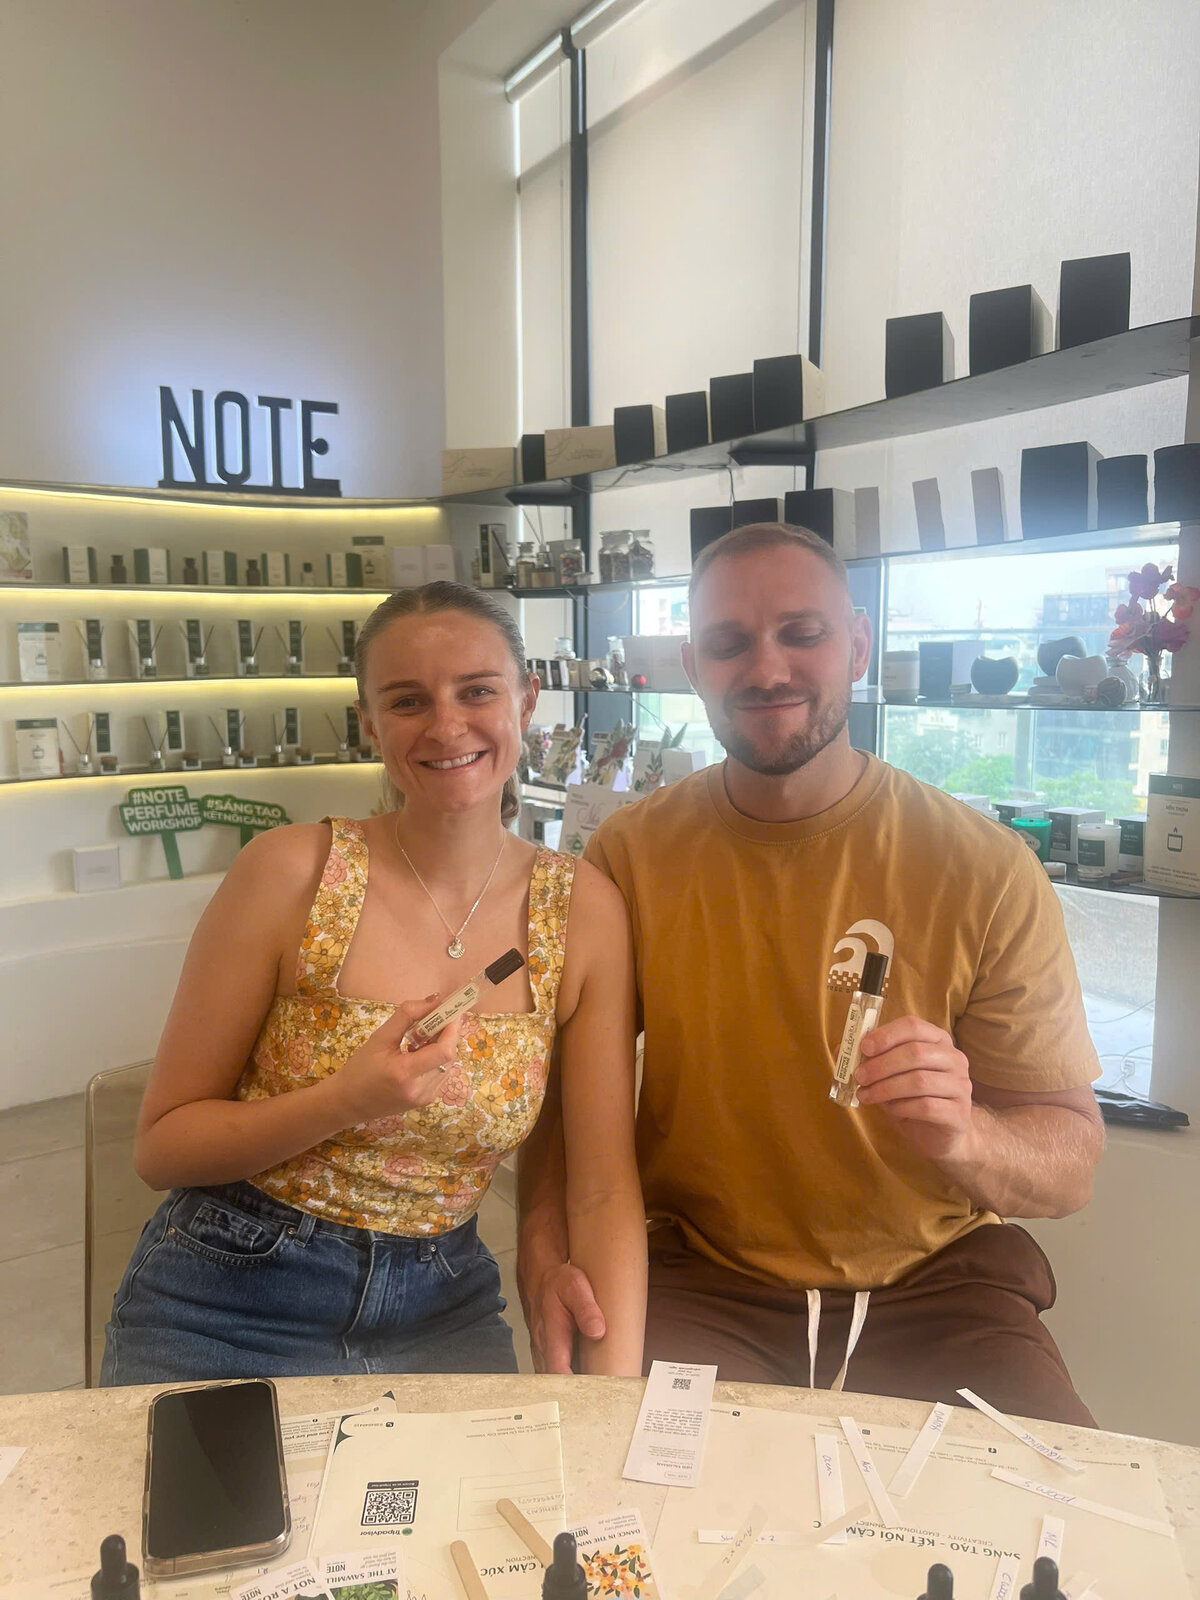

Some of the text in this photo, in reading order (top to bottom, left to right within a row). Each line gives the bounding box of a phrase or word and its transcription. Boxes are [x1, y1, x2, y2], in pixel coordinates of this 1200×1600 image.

[158, 386, 341, 496] NOTE
[132, 789, 185, 805] #NOTE
[123, 802, 199, 820] PERFUME
[127, 817, 201, 832] WORKSHOP
[427, 1017, 445, 1032] PERFUME
[618, 1528, 640, 1537] DANCE
[845, 1527, 875, 1538] CẢM
[880, 1531, 904, 1542] NỐI
[577, 1539, 592, 1547] WIN
[594, 1535, 606, 1543] THE
[909, 1536, 935, 1548] KẾT
[947, 1534, 993, 1547] CREATIVITY
[950, 1543, 978, 1555] TẠO
[505, 1555, 536, 1563] NECTION
[326, 1564, 346, 1574] NOTE
[480, 1566, 505, 1577] XÚC
[509, 1562, 536, 1574] CẢM
[325, 1567, 397, 1584] AT THE SAWMILL
[292, 1577, 316, 1590] NOT
